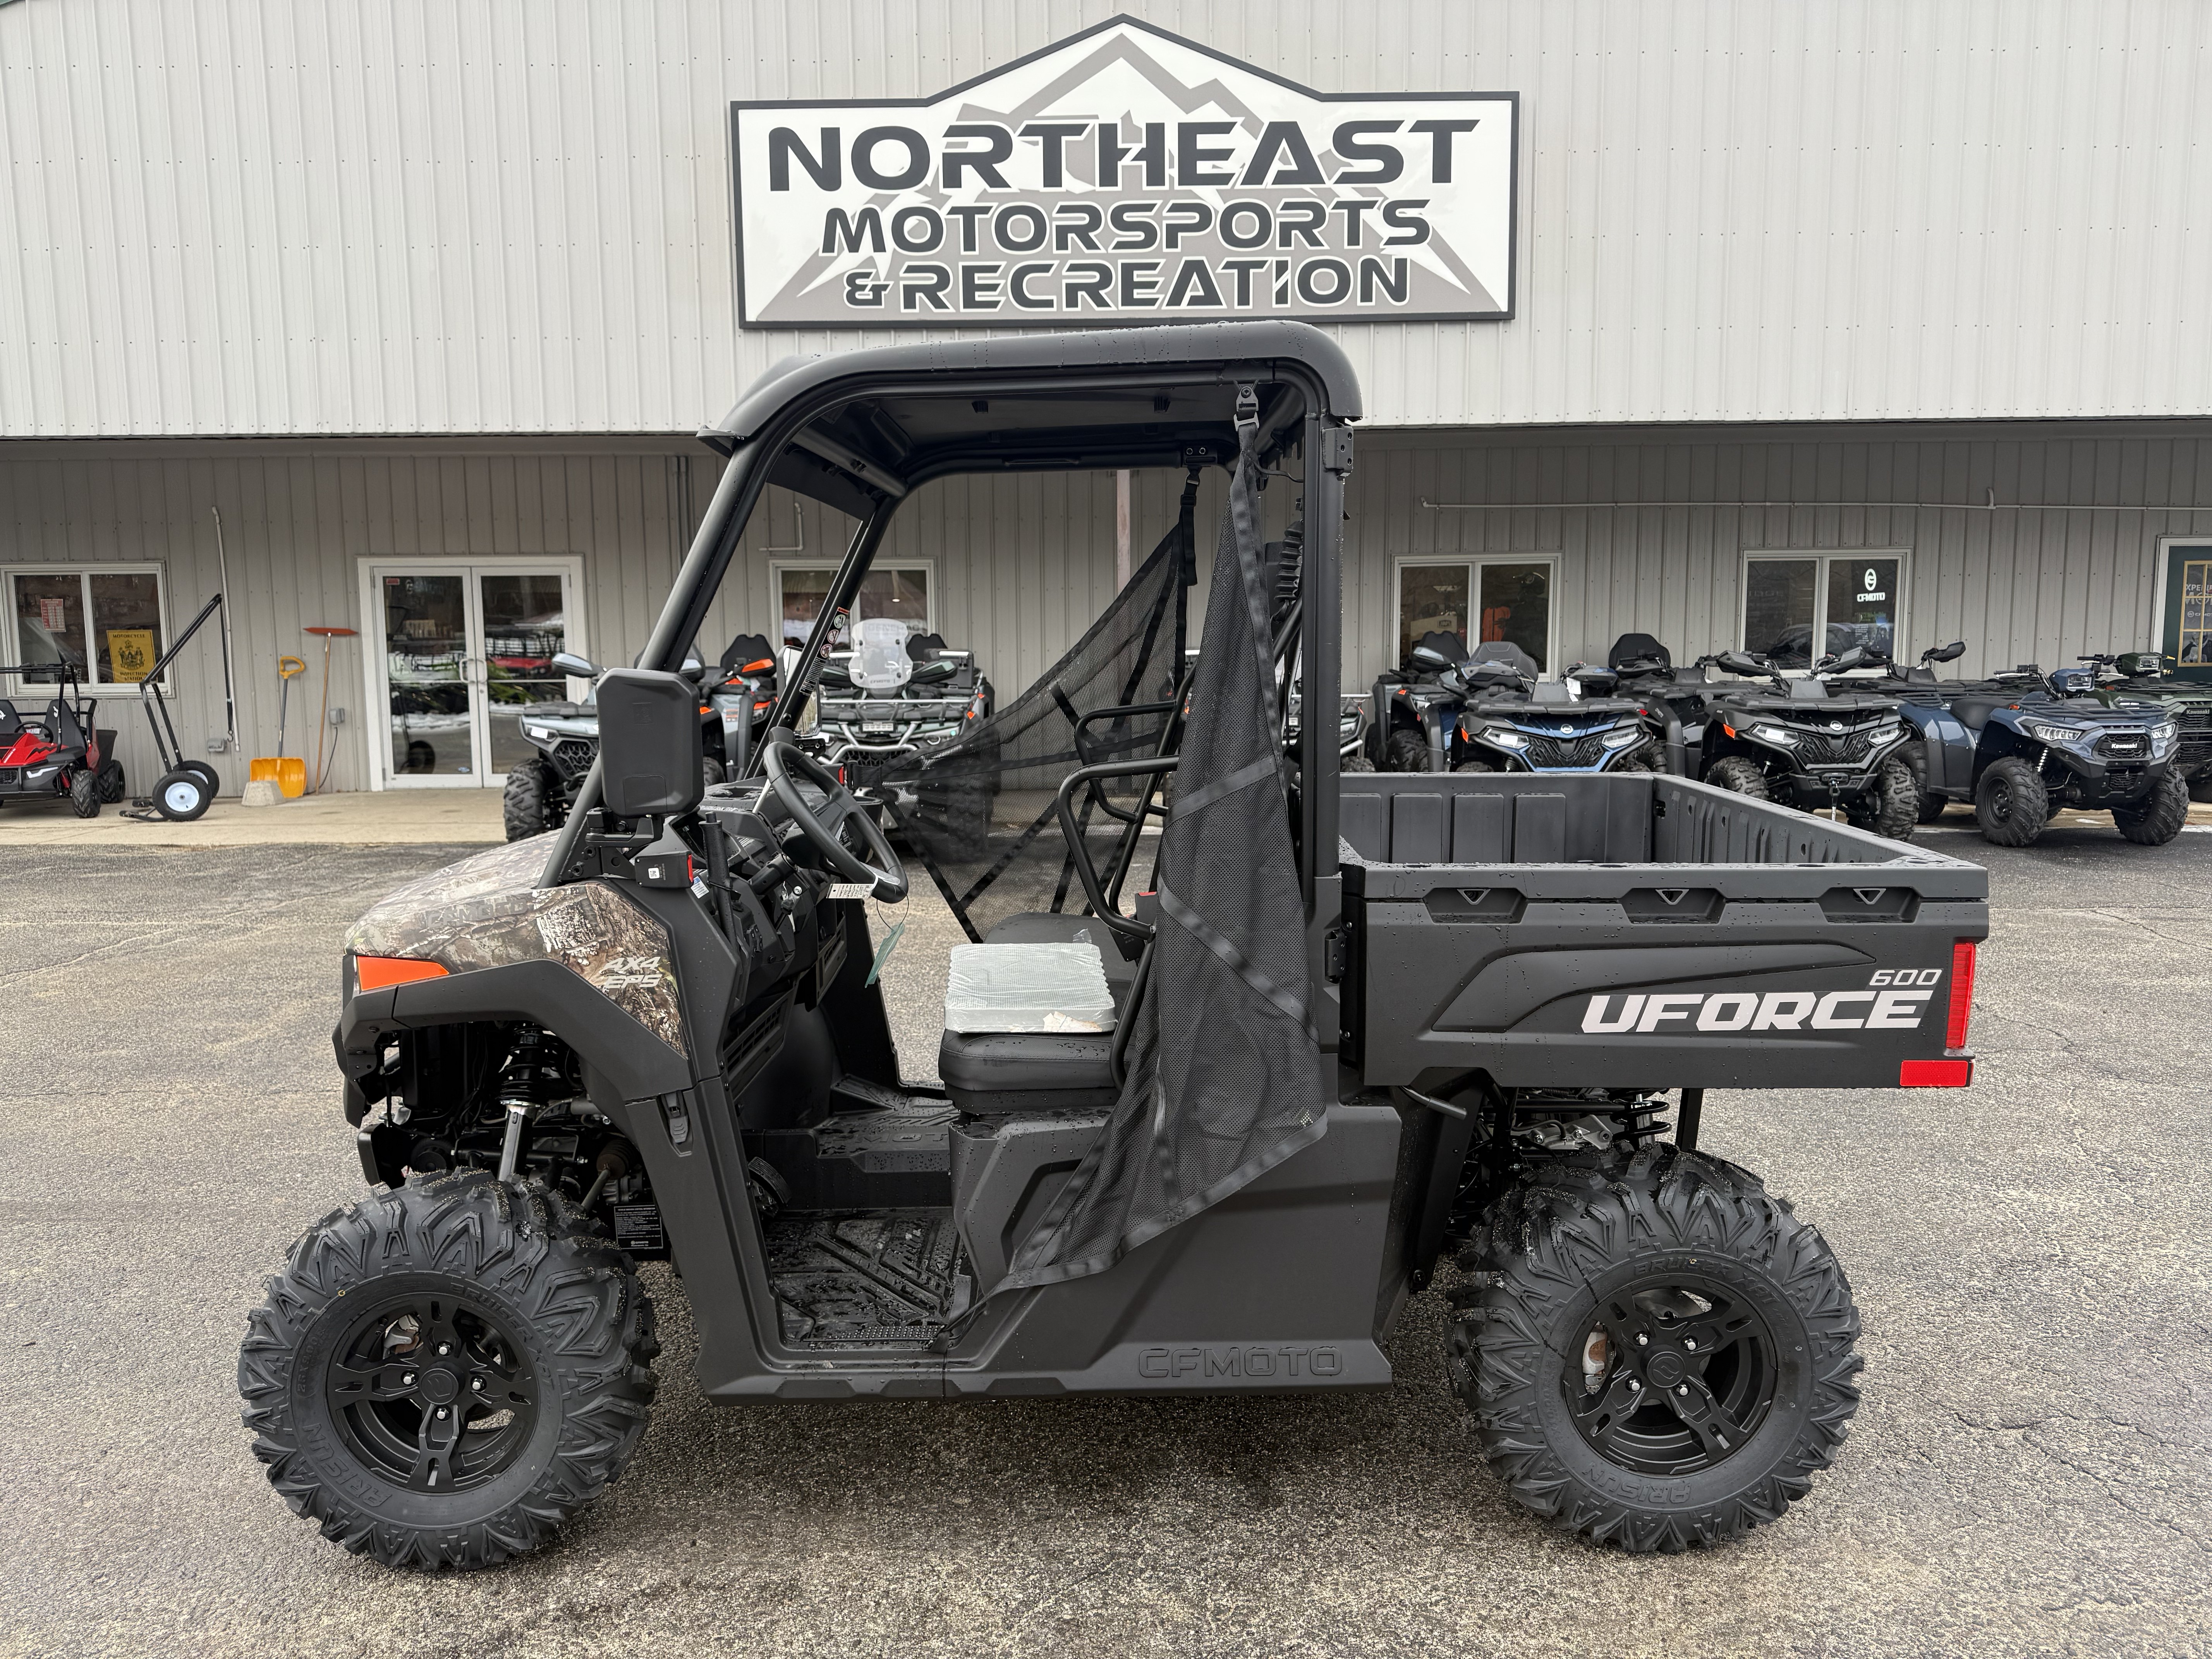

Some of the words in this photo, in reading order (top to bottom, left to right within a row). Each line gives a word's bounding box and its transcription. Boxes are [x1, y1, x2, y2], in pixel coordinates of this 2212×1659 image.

[769, 119, 1480, 191] NORTHEAST
[822, 200, 1431, 253] MOTORSPORTS
[1857, 592, 1886, 602] CFMOTO
[428, 899, 528, 927] CFMOTO
[605, 957, 661, 971] 4X4
[1869, 969, 1942, 986] 600
[605, 974, 662, 989] EPS
[1581, 990, 1934, 1033] UFORCE
[1634, 1257, 1733, 1275] BRUISER
[450, 1282, 533, 1342] BRUISER
[1139, 1347, 1342, 1377] CFMOTO
[302, 1422, 393, 1507] ARISUN
[1582, 1462, 1692, 1503] ARISUN
